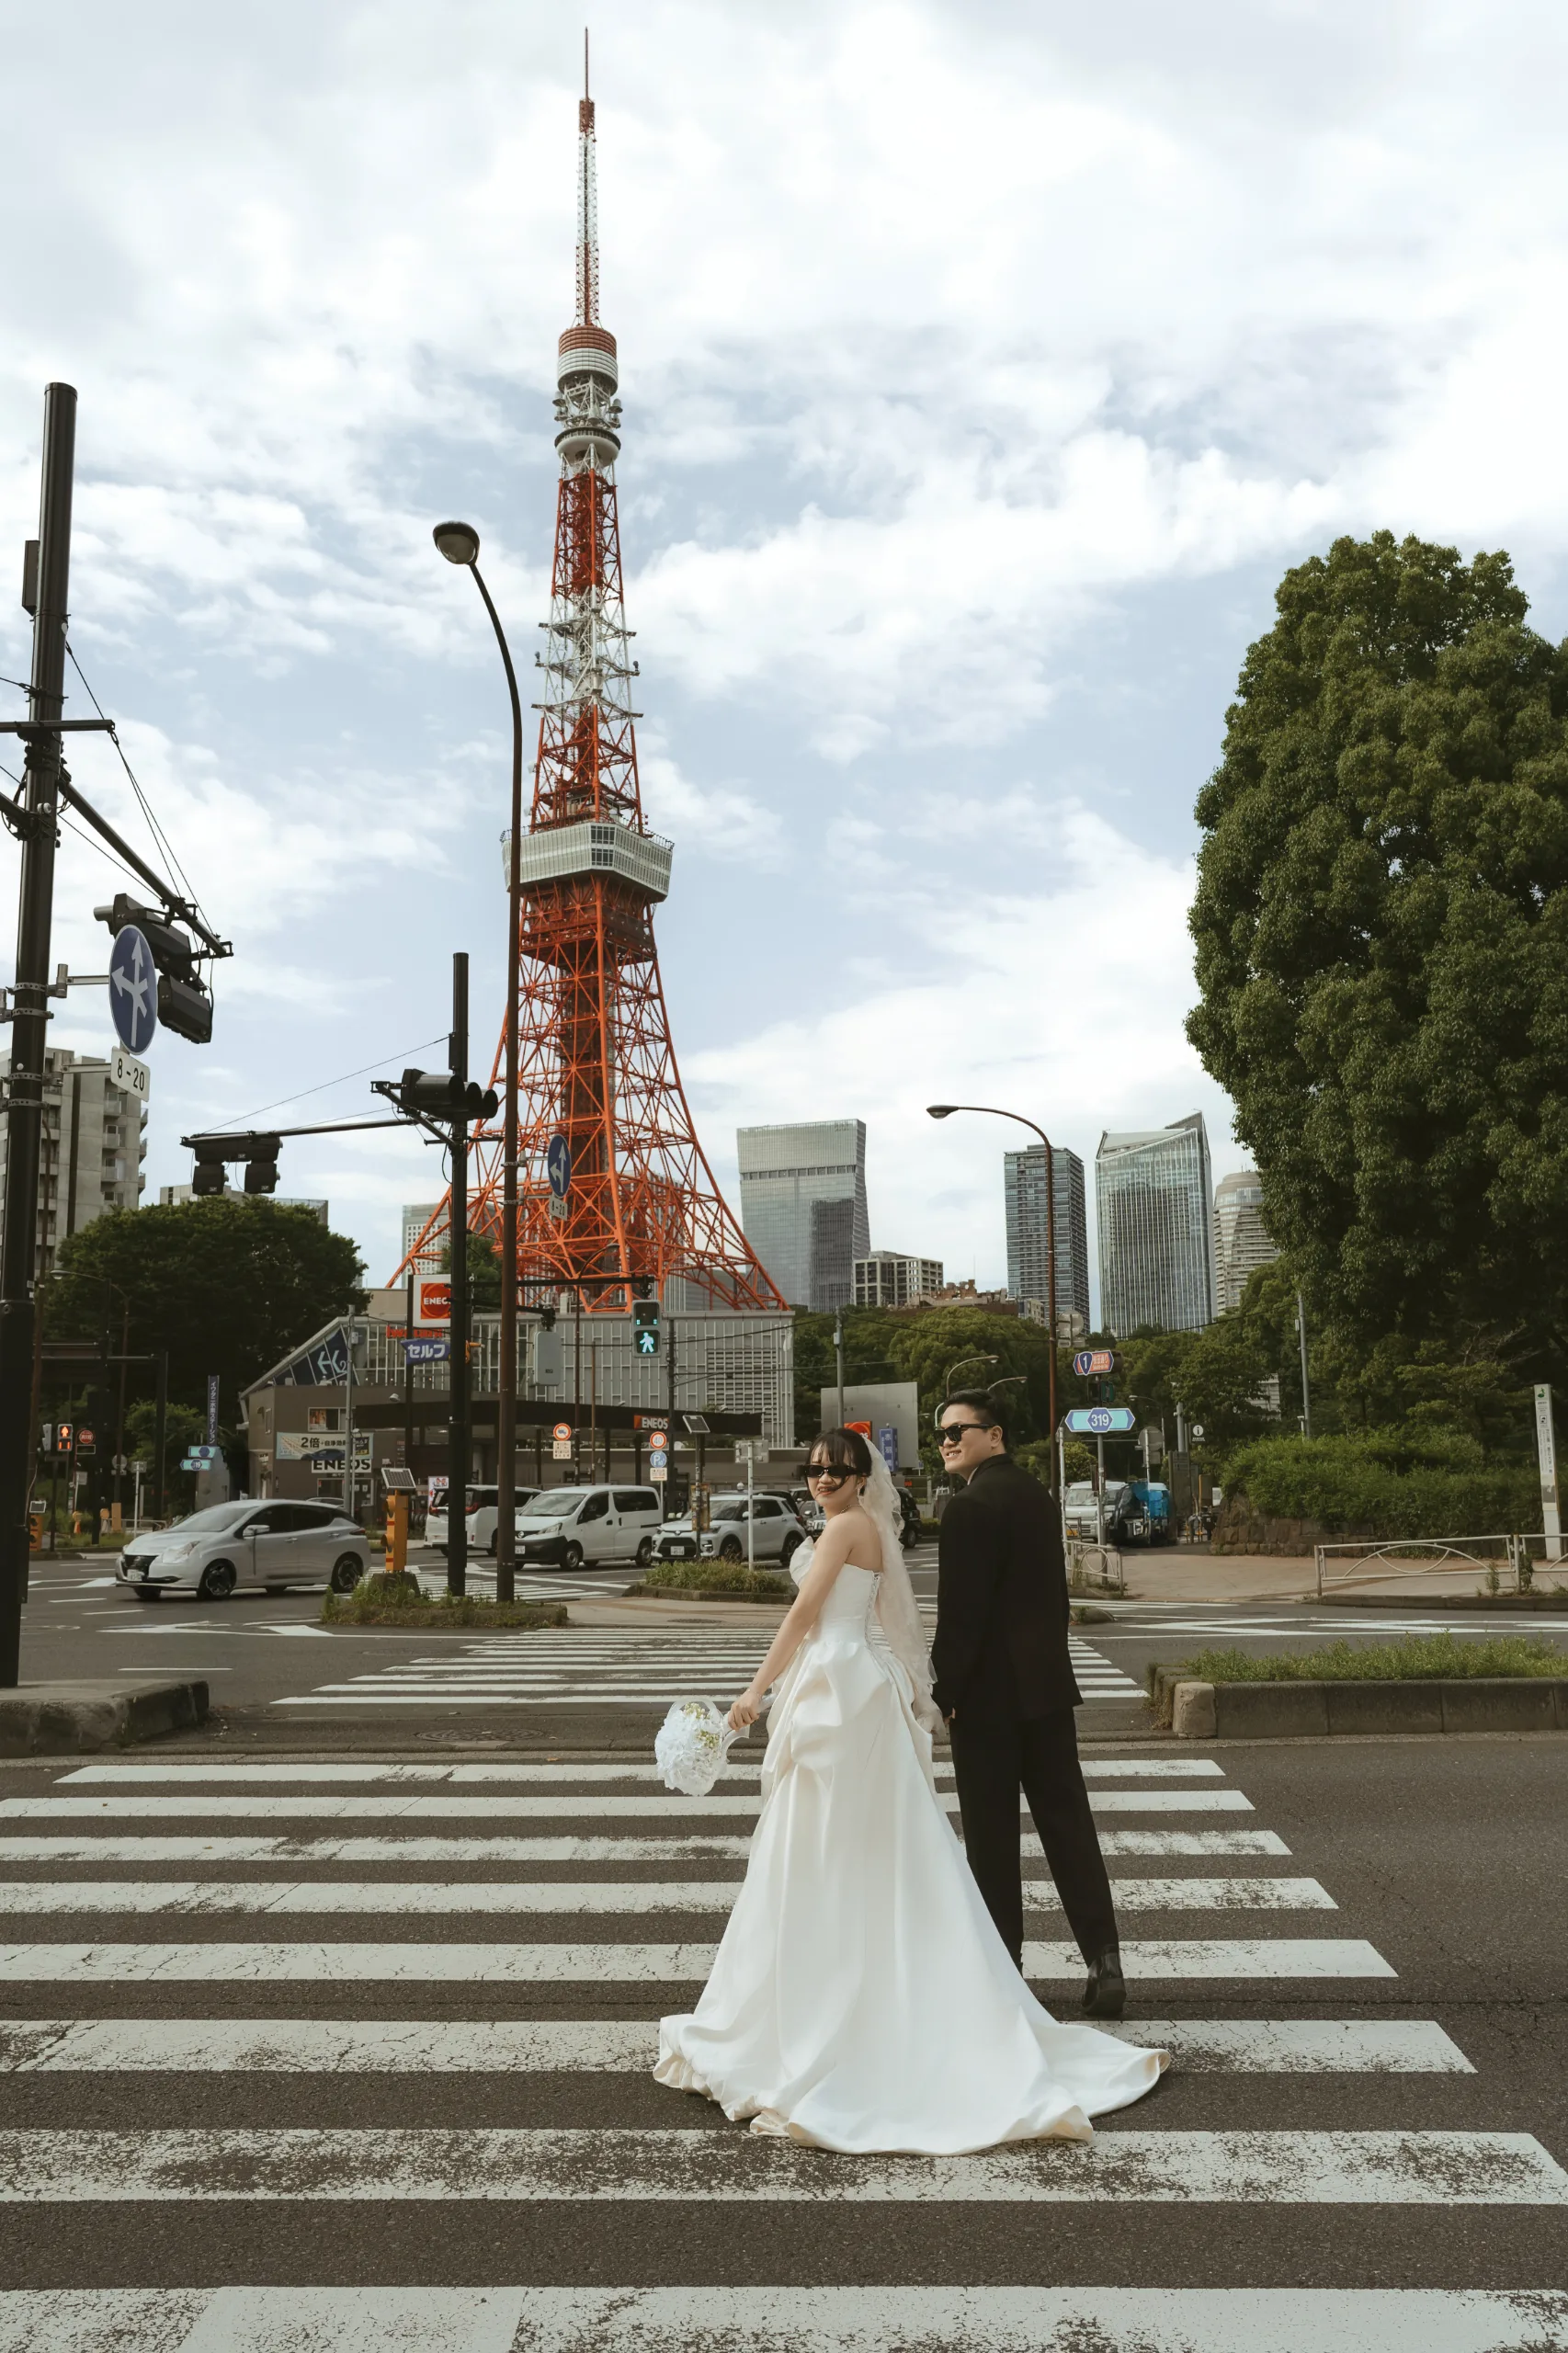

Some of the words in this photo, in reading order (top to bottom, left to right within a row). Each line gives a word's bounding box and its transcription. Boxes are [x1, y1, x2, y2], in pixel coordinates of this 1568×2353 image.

[117, 1057, 145, 1092] 8-20
[423, 1297, 451, 1305] ENEO
[407, 1344, 446, 1358] セルフ
[1083, 1355, 1087, 1370] 1
[642, 1417, 668, 1429] ENEOS
[1091, 1414, 1109, 1427] 319
